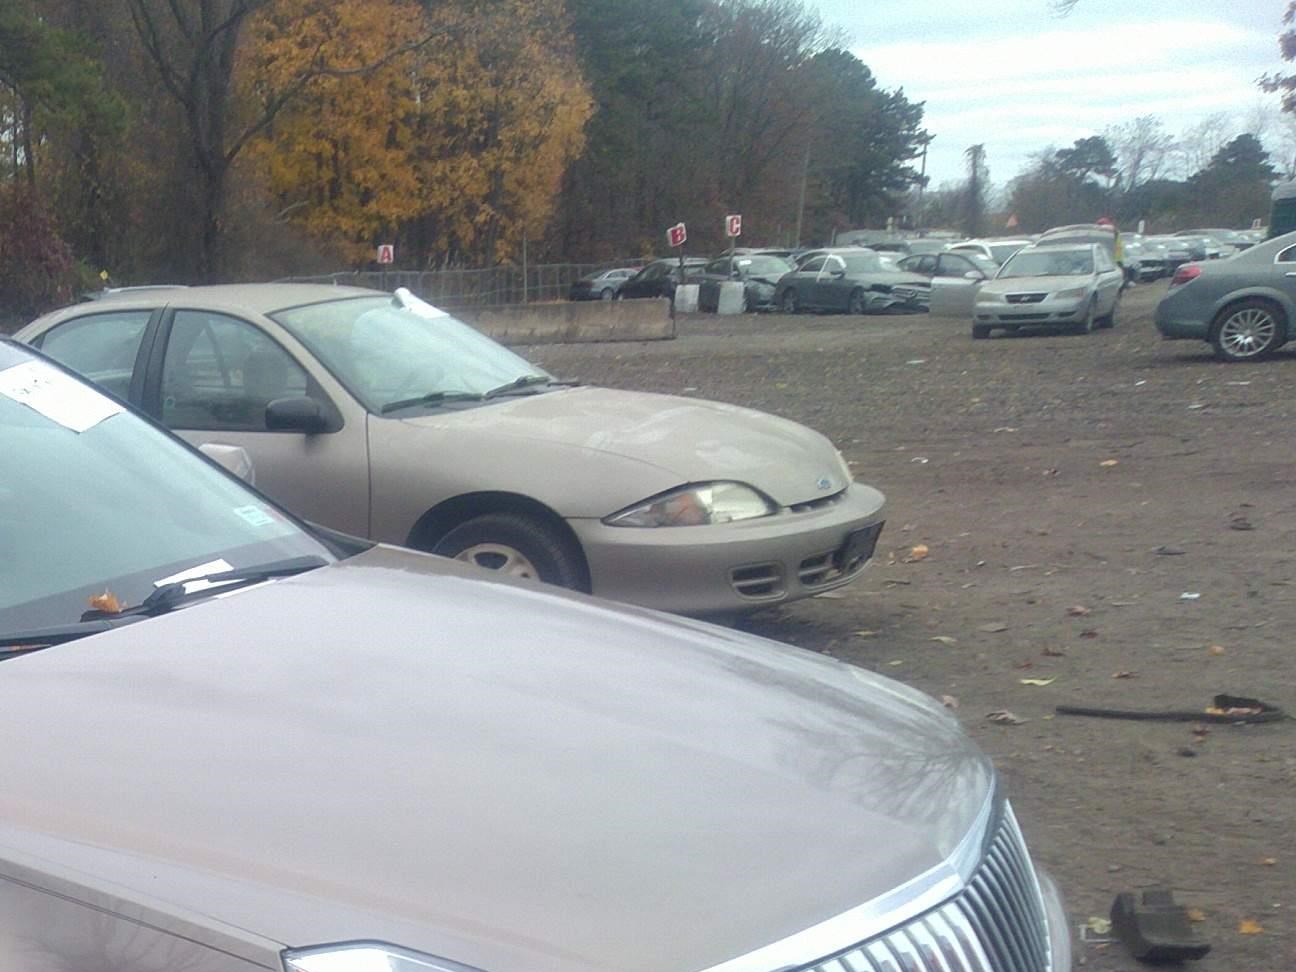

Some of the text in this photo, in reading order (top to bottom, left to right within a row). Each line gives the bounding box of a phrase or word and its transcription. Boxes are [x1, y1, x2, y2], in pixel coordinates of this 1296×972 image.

[730, 217, 740, 234] C
[671, 227, 684, 245] B
[380, 246, 392, 262] A
